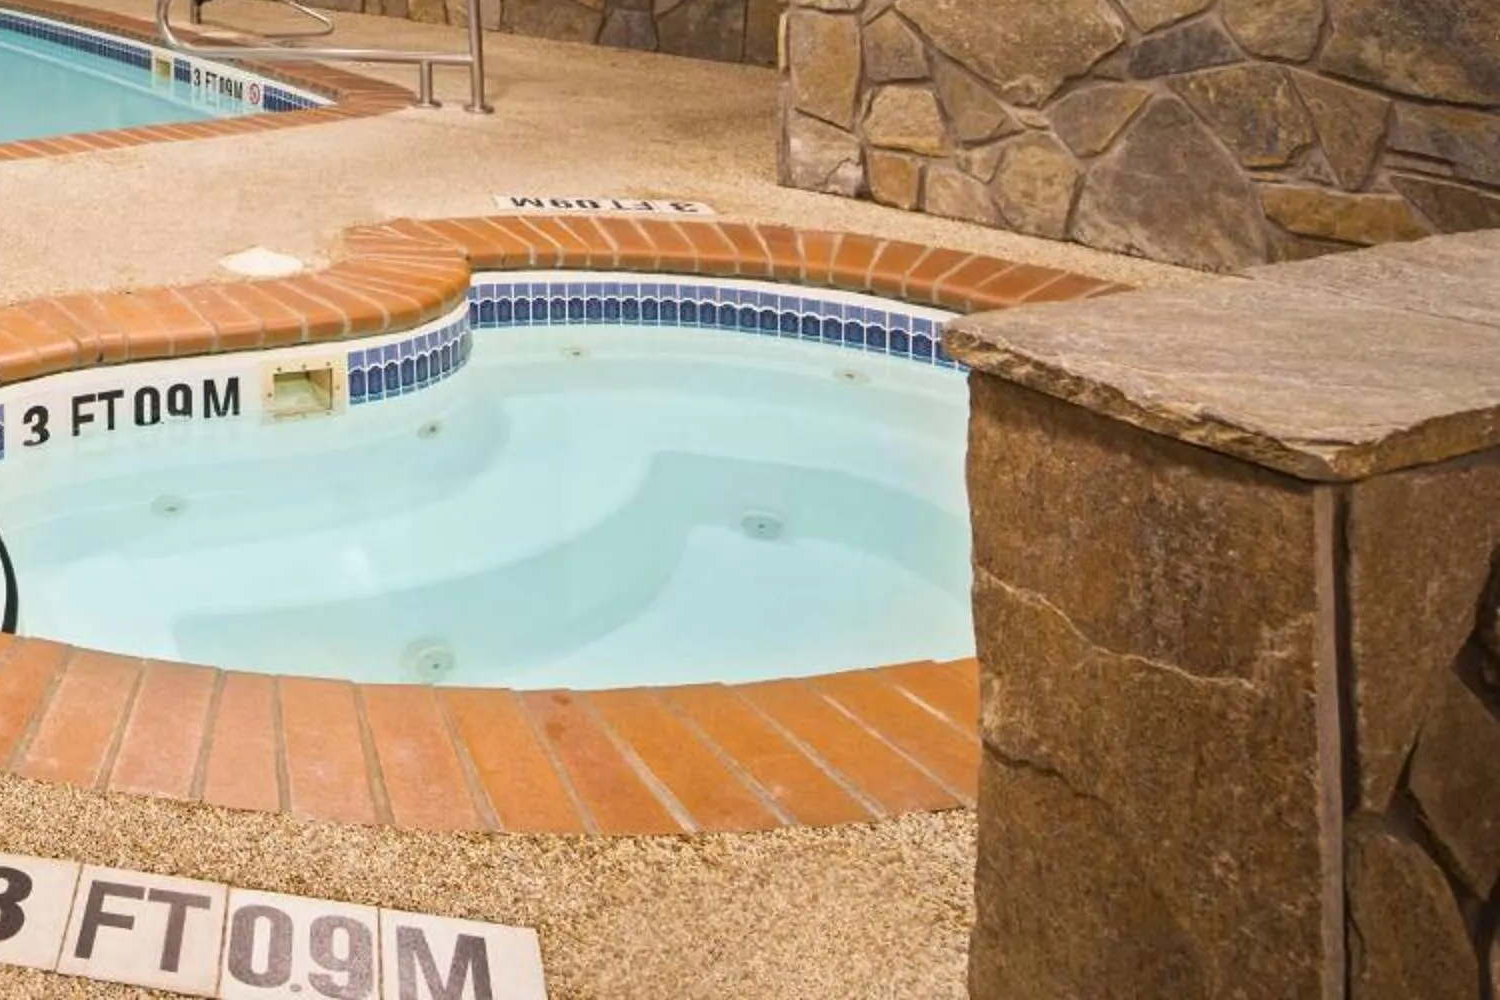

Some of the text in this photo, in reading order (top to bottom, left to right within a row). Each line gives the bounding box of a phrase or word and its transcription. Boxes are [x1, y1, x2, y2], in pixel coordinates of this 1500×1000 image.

[194, 68, 201, 87] 3
[23, 405, 50, 447] 3
[71, 389, 125, 437] FT
[202, 377, 241, 419] M
[73, 880, 211, 973] FT
[398, 925, 492, 1000] M
